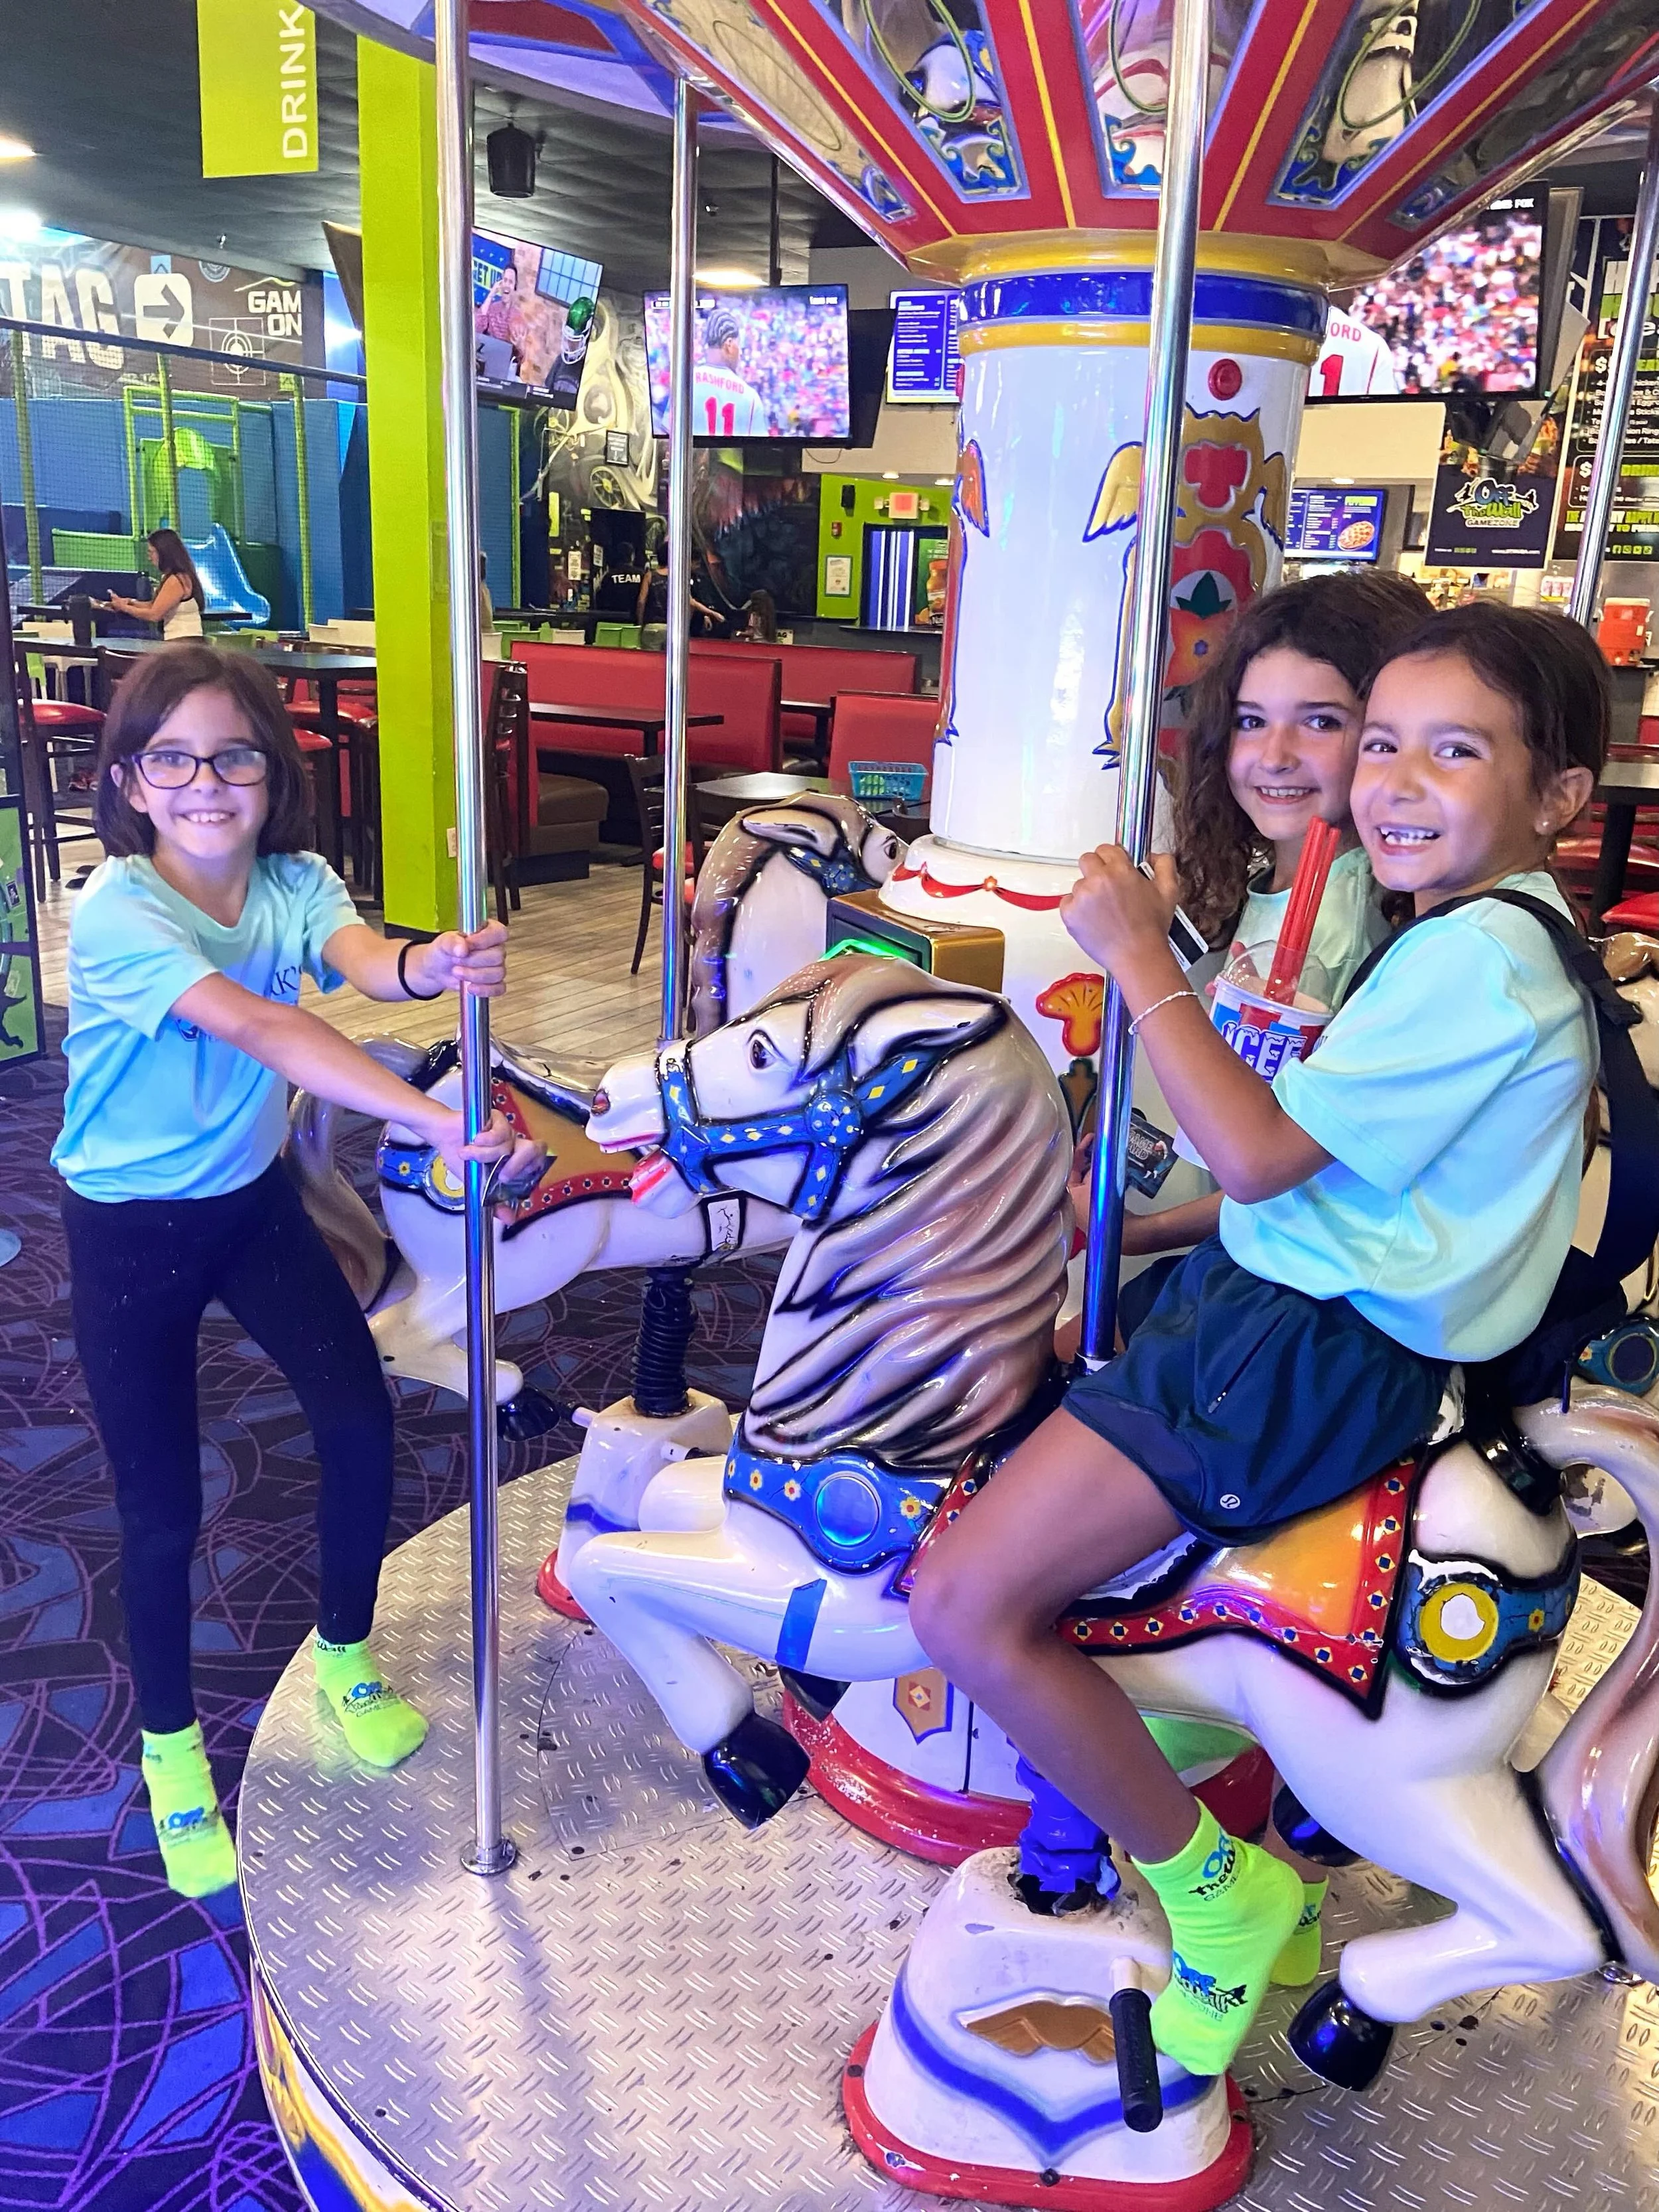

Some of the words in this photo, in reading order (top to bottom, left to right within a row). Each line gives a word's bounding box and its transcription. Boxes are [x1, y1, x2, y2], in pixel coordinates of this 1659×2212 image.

[279, 5, 307, 159] DRINK
[0, 263, 124, 370] TAG
[267, 314, 302, 336] ON
[695, 371, 745, 394] RASHFORD
[705, 396, 735, 436] 11
[611, 574, 641, 584] TEAM
